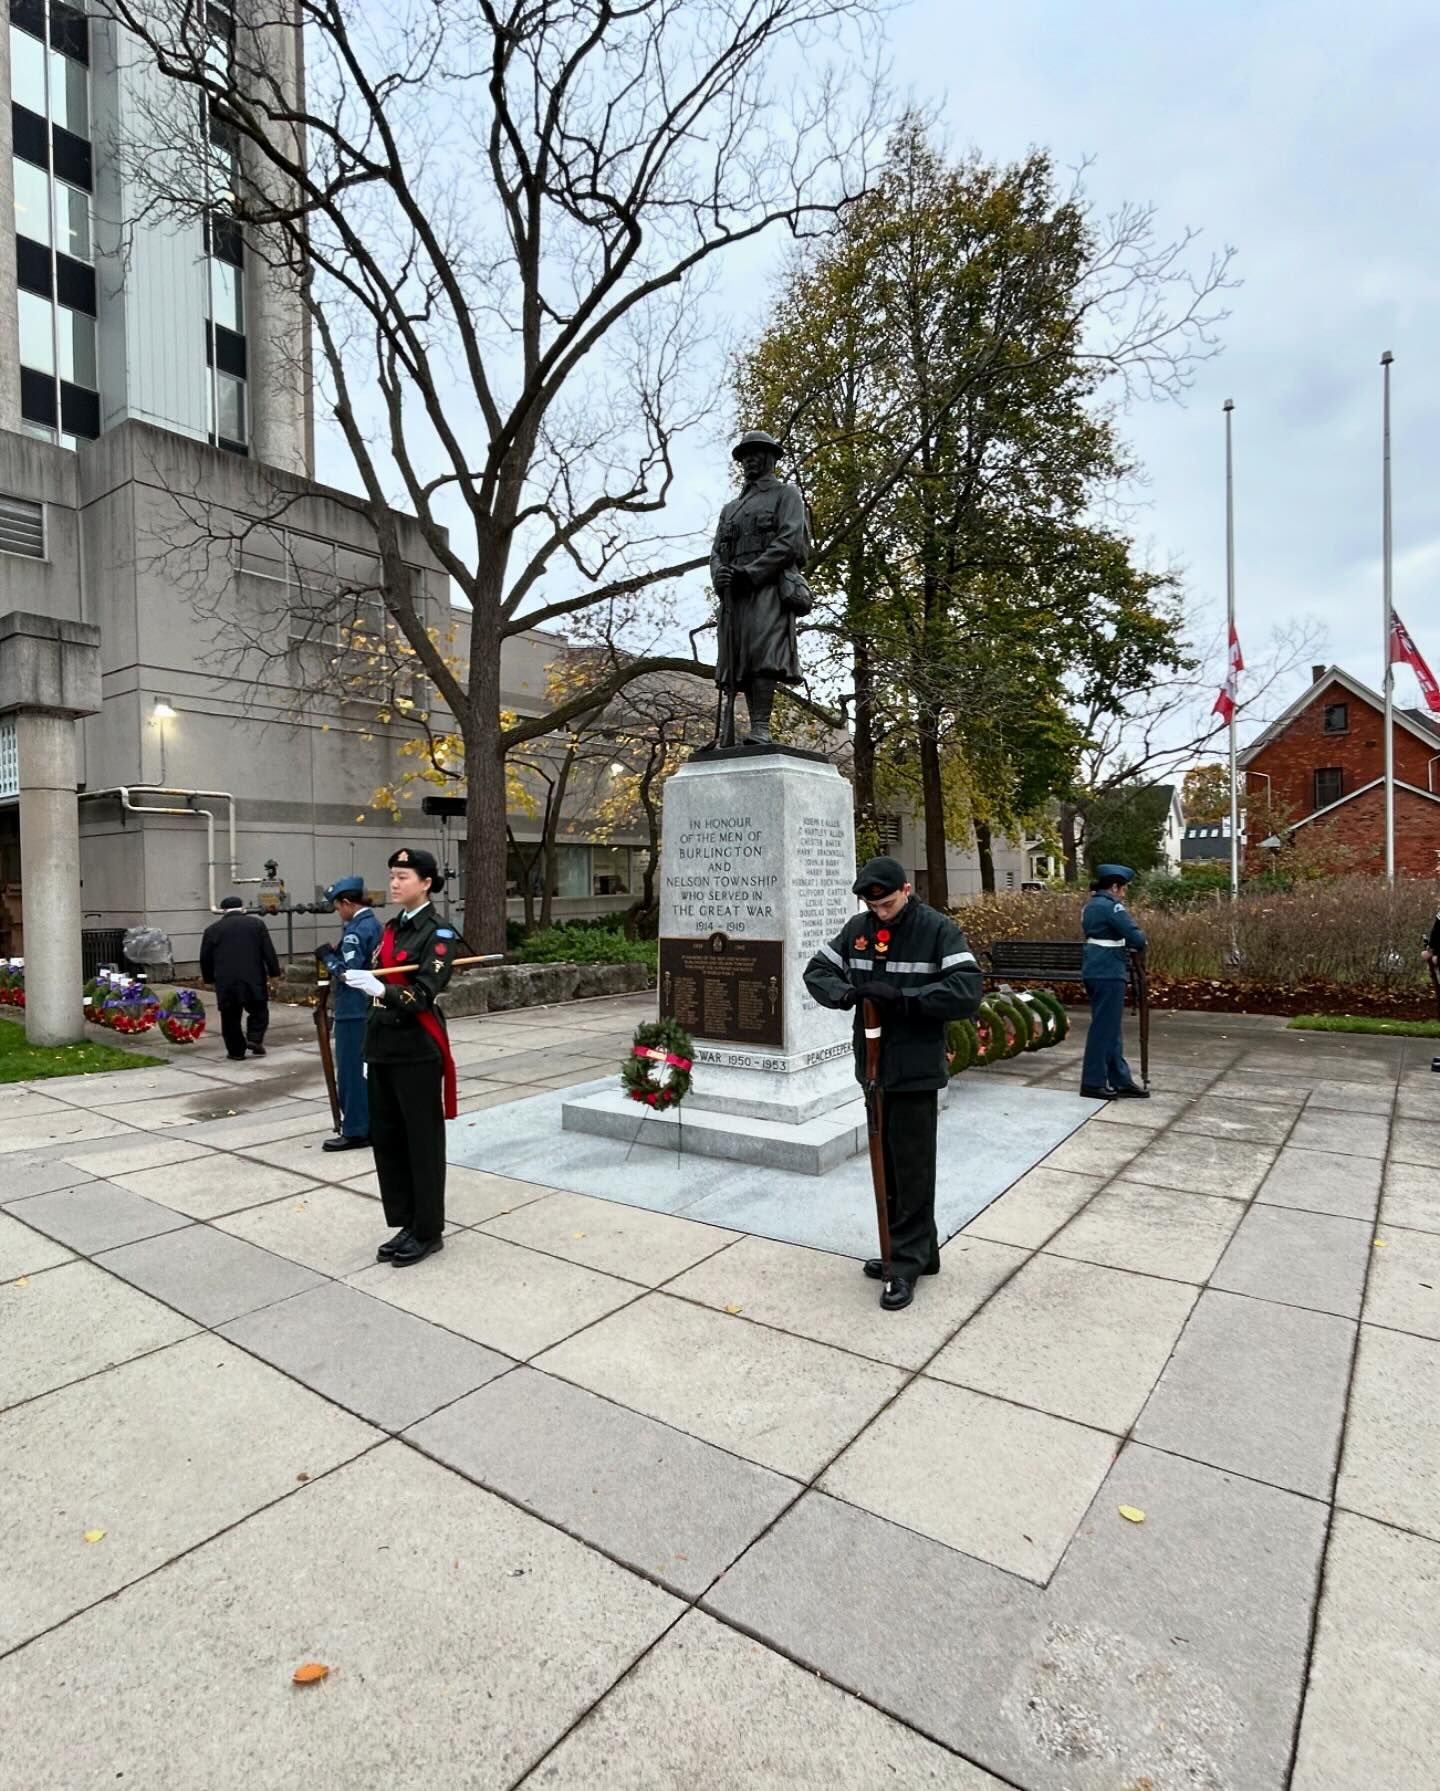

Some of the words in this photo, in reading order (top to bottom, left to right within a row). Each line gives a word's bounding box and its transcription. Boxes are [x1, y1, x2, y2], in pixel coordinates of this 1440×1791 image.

[690, 820, 701, 830] IN
[705, 817, 752, 829] HONOUR
[680, 834, 694, 844] OF
[696, 833, 716, 843] THE
[720, 831, 743, 842] MEN
[747, 831, 762, 841] OF
[679, 846, 763, 859] BURLINGTON
[708, 862, 732, 872] AND
[666, 876, 710, 887] NELSON
[713, 875, 778, 888] TOWNSHIP
[681, 891, 704, 901] WHO
[708, 890, 749, 901] SERVED
[753, 891, 763, 901] IN
[672, 904, 695, 916] THE
[699, 905, 740, 917] GREAT
[746, 905, 774, 917] WAR
[696, 921, 714, 931] 1914
[726, 921, 746, 932] 1919
[698, 1050, 722, 1063] WAR
[728, 1055, 752, 1067] 1950
[762, 1059, 786, 1071] 1953
